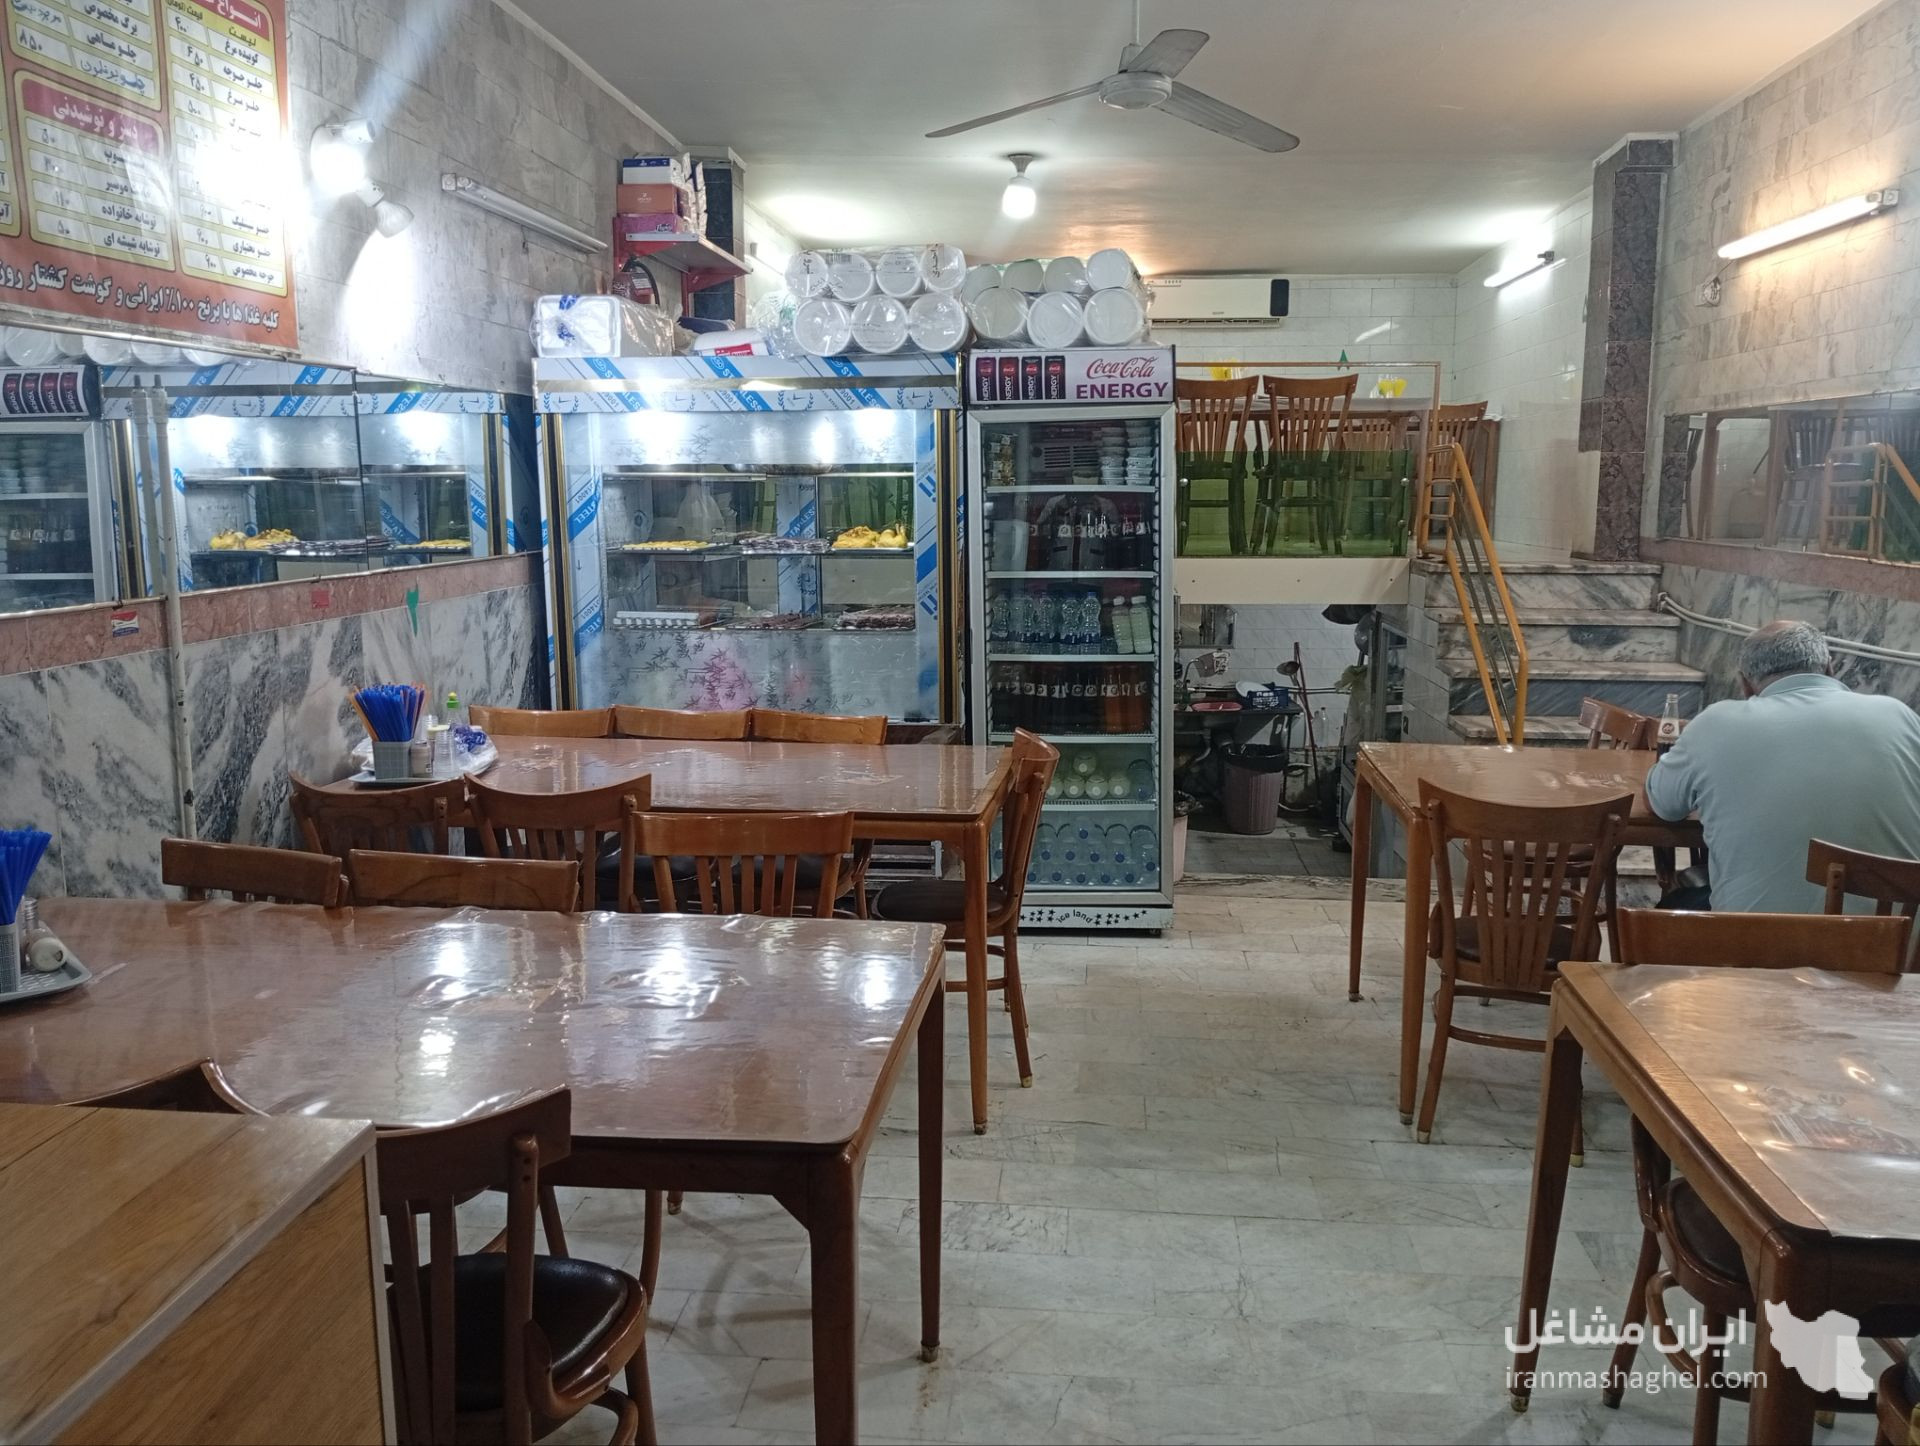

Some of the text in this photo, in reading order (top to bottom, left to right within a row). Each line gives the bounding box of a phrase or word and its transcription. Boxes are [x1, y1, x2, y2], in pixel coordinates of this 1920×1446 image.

[52, 96, 106, 132] نوشیدنی
[28, 261, 68, 292] کشتار
[70, 273, 113, 304] گوشت
[125, 280, 164, 313] ایرانی
[197, 296, 221, 323] برنج
[262, 308, 281, 333] کلیه
[1086, 356, 1158, 379] Coca-Cola
[1076, 382, 1169, 400] ENERGY
[1072, 909, 1093, 924] land
